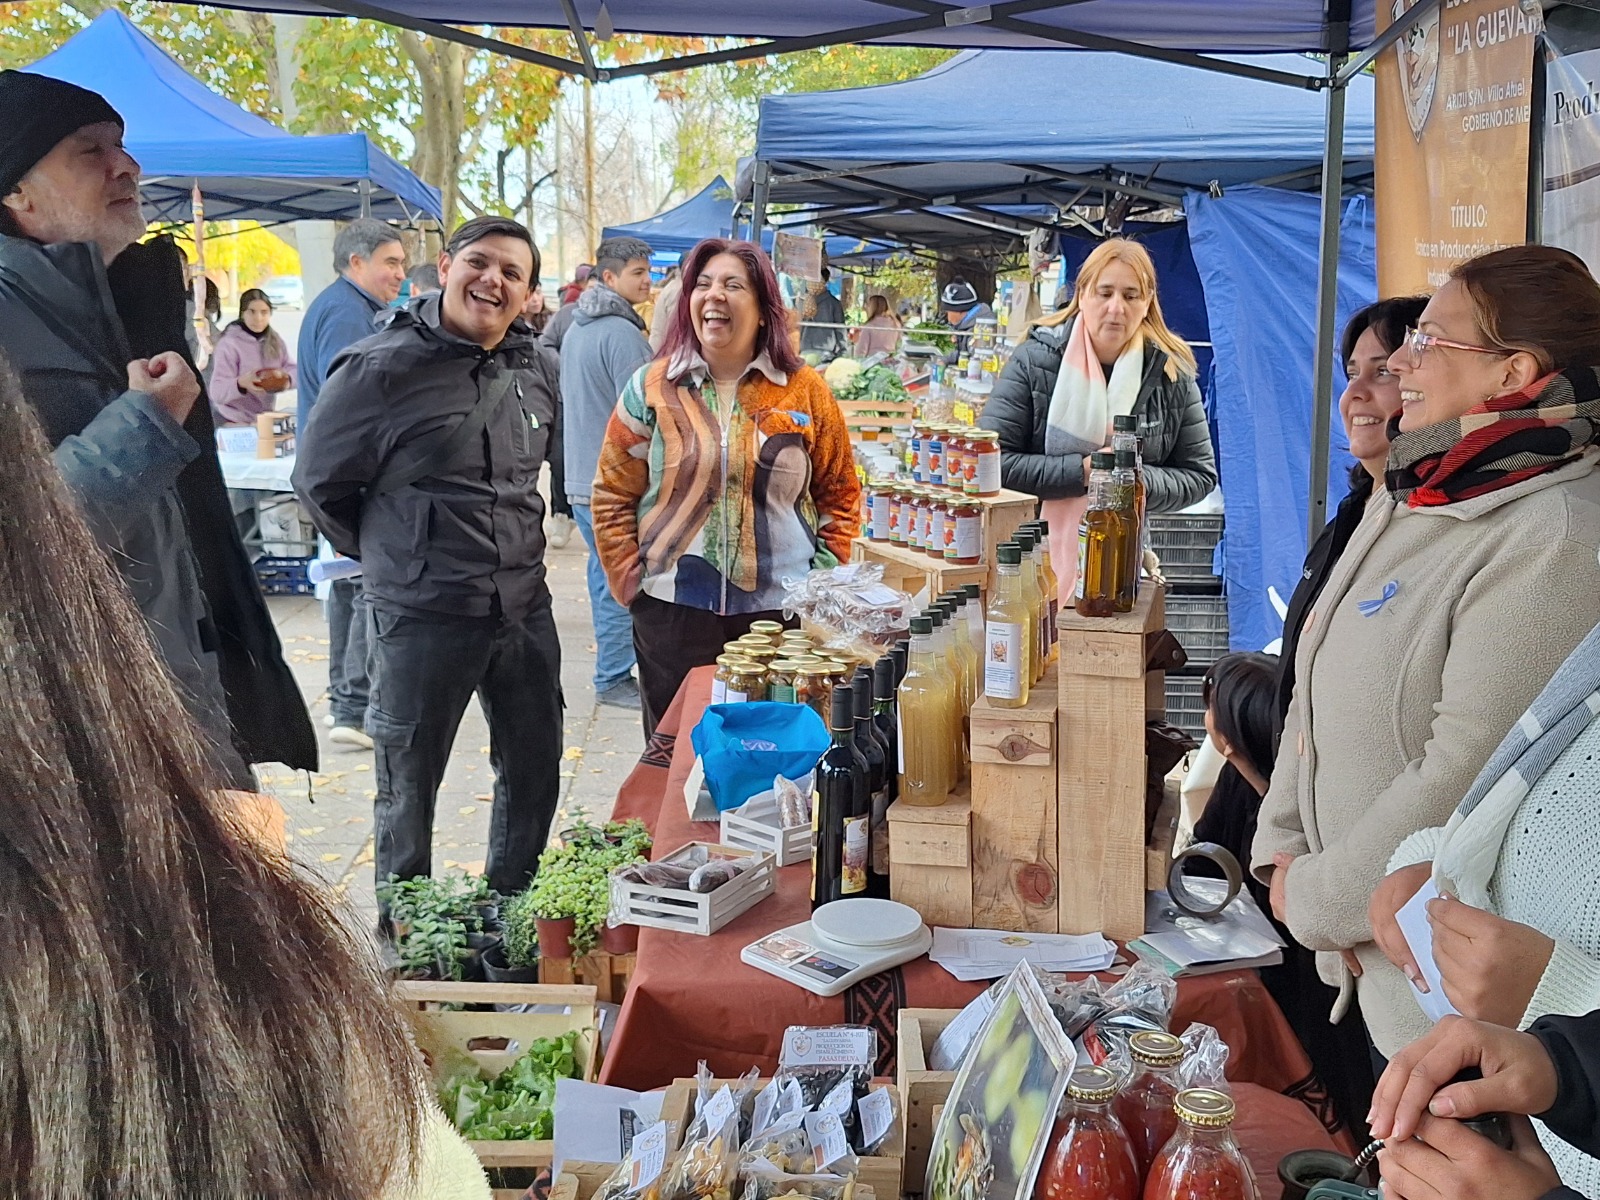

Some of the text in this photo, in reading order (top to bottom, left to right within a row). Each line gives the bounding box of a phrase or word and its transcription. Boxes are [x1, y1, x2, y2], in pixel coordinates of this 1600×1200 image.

[1446, 92, 1467, 111] ARIZU
[1487, 84, 1504, 102] Villa
[1462, 110, 1503, 132] GOBIERNO
[1504, 107, 1514, 126] DE
[1450, 199, 1488, 228] TÍTULO:
